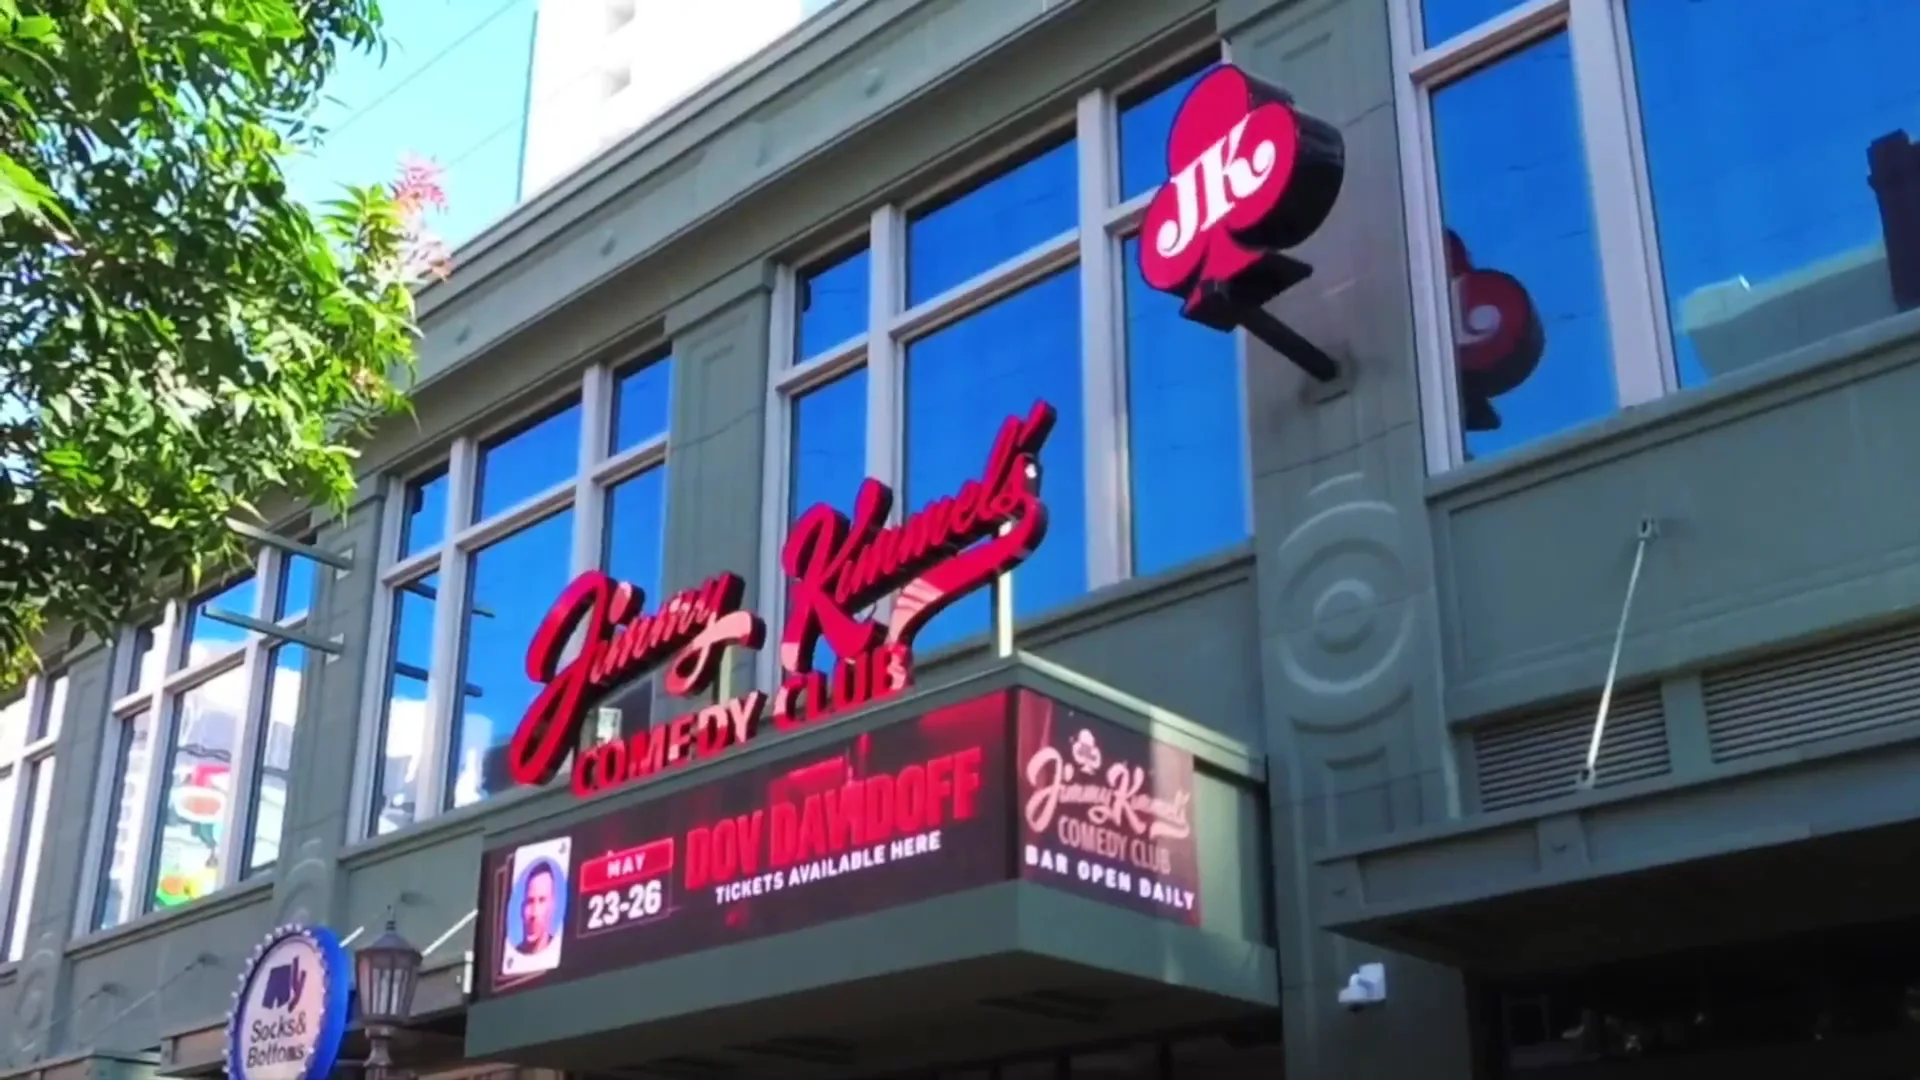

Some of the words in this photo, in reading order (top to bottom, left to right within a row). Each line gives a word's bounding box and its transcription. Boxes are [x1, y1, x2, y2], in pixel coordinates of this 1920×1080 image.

[1156, 113, 1276, 258] JK
[508, 569, 764, 785] Jimmy
[781, 400, 1052, 672] Kimmel's
[571, 690, 762, 797] COMEDY
[773, 641, 912, 732] CLUB
[684, 810, 764, 891] DOV
[770, 746, 982, 868] DAVIDOFF
[1025, 746, 1116, 833] Jimmy
[607, 852, 646, 879] MAY
[715, 871, 785, 905] TICKETS
[788, 844, 886, 888] AVAILABLE
[890, 830, 942, 861] HERE
[1025, 845, 1069, 875] BAR
[1077, 859, 1132, 893] OPEN
[1139, 876, 1196, 911] DAILY
[1057, 815, 1128, 862] COMEDY
[1130, 838, 1172, 875] CLUB
[587, 879, 662, 930] 23-26
